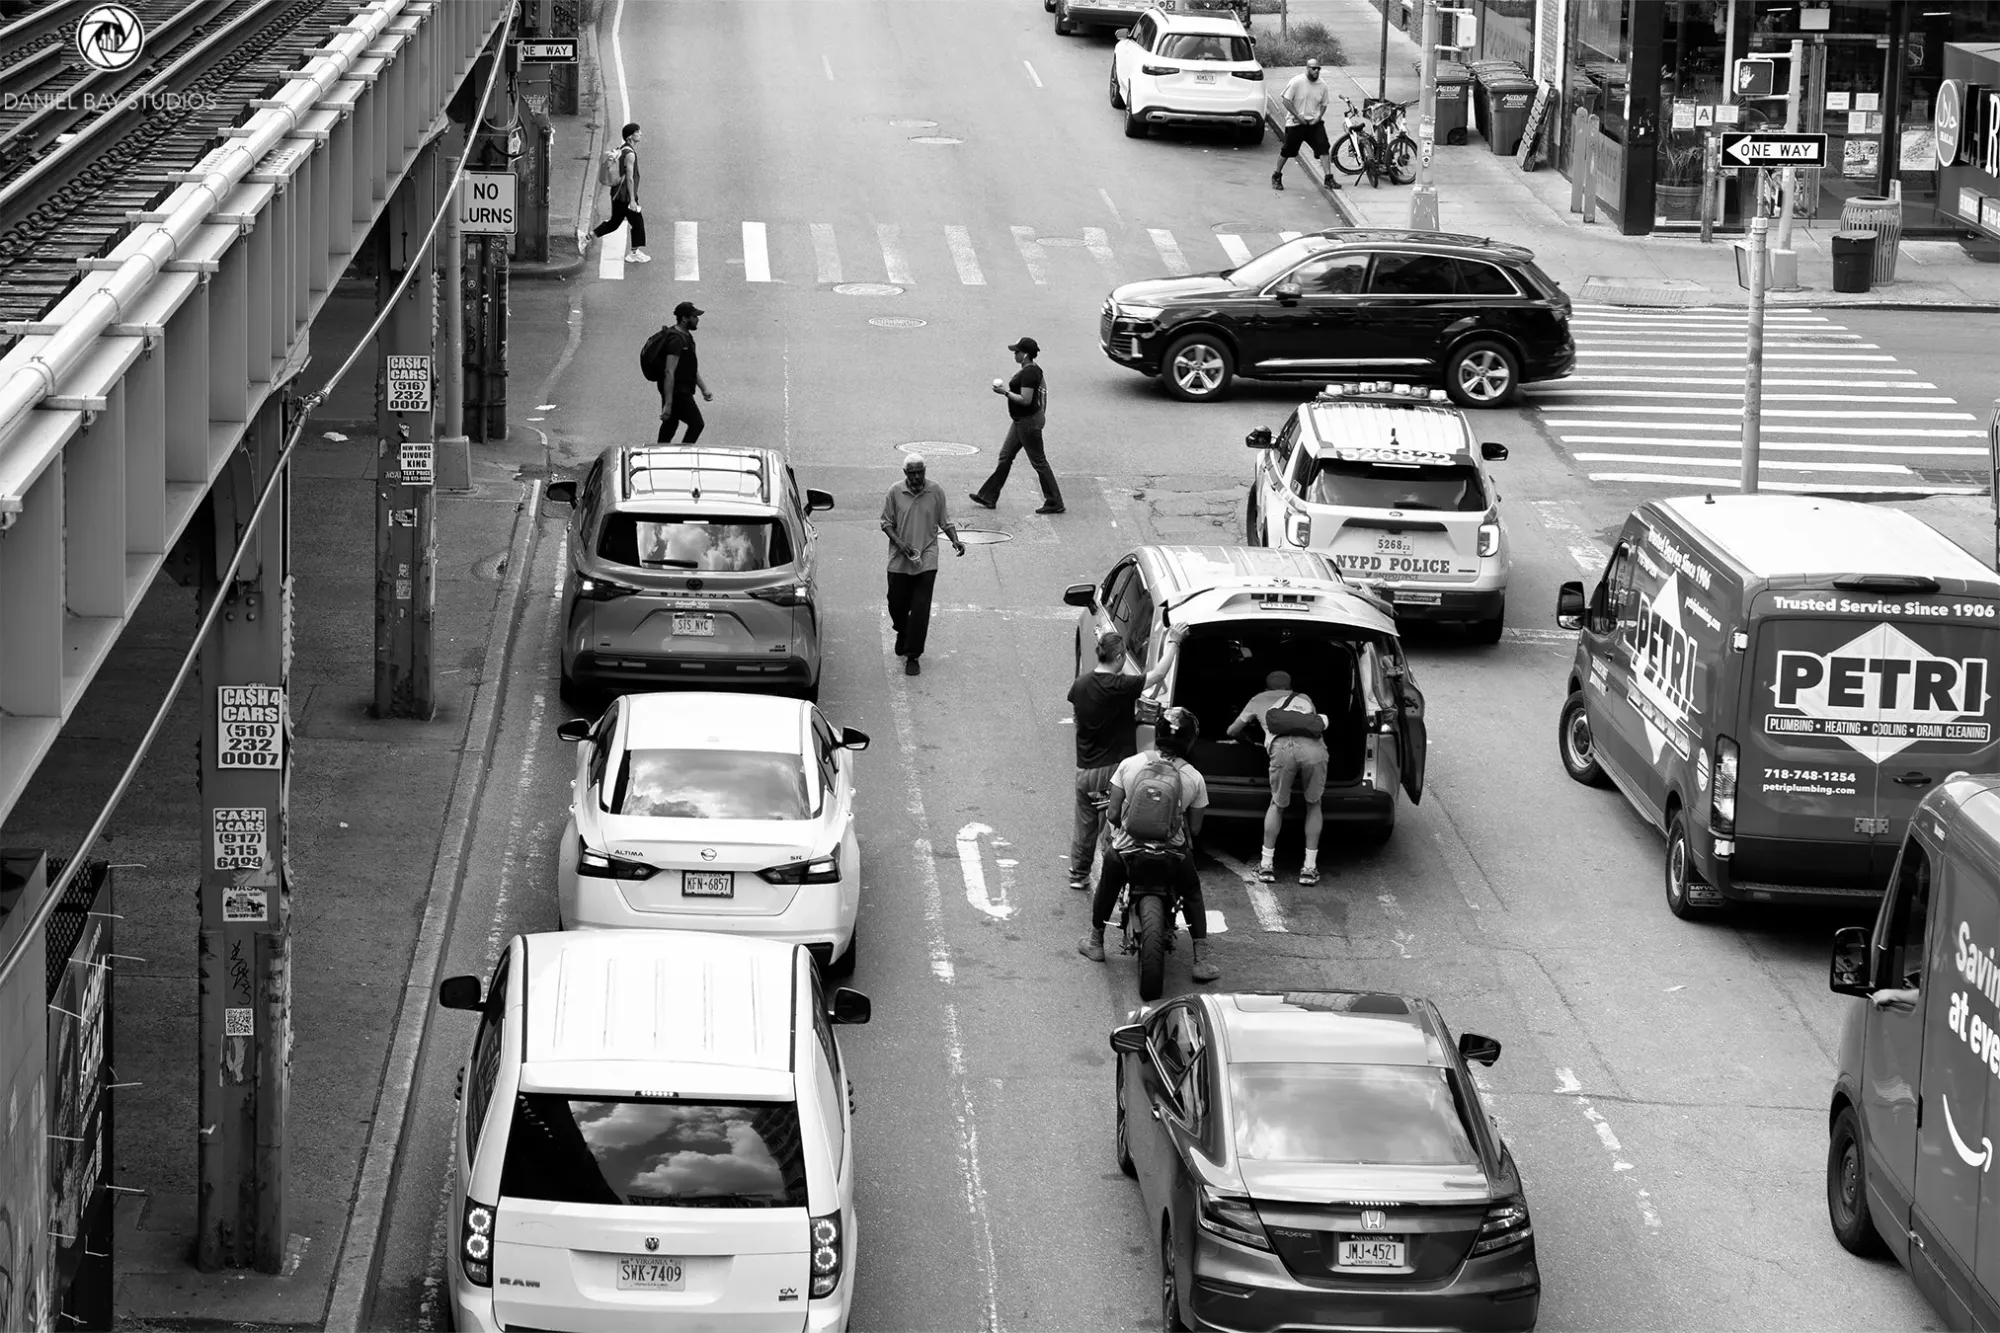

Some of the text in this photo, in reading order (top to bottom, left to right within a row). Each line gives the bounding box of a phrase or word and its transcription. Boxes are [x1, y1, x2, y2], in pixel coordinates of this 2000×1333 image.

[522, 46, 568, 56] NE WAY
[1699, 108, 1710, 120] A
[1740, 144, 1811, 157] ONE WAY
[474, 183, 499, 200] NO
[469, 208, 513, 224] URNS
[421, 358, 428, 369] 4
[390, 369, 428, 380] CARS
[393, 381, 425, 391] (516)
[394, 391, 424, 400] 232
[390, 400, 428, 410] 0007
[407, 460, 427, 468] KING
[1340, 449, 1456, 466] 526822
[1378, 539, 1402, 550] 5268
[1336, 555, 1450, 574] NYPD POLICE
[1774, 596, 1996, 618] Trusted Service Since 1906
[678, 619, 709, 631] STS NYC
[1636, 592, 1698, 702] PETRI
[1776, 651, 1986, 715] PETRI
[270, 691, 280, 706] 4
[223, 706, 278, 722] CARS
[226, 724, 275, 738] (516)
[1770, 718, 1986, 739] PLUMBING HEATING COOLING DRAIN CLEANING
[228, 738, 272, 751] 232
[221, 752, 279, 766] 0007
[1764, 768, 1856, 783] 718-748-1254
[1762, 783, 1856, 796] petriplumbing.com
[219, 833, 262, 844] (917)
[224, 844, 258, 856] 515
[614, 849, 644, 857] ALTIMA
[217, 856, 263, 868] 6499
[1956, 921, 2000, 1010] Savin
[1949, 991, 1969, 1042] at
[635, 1257, 668, 1266] VIRGINIA
[622, 1265, 682, 1282] SWK-7409
[500, 1277, 540, 1288] RAM
